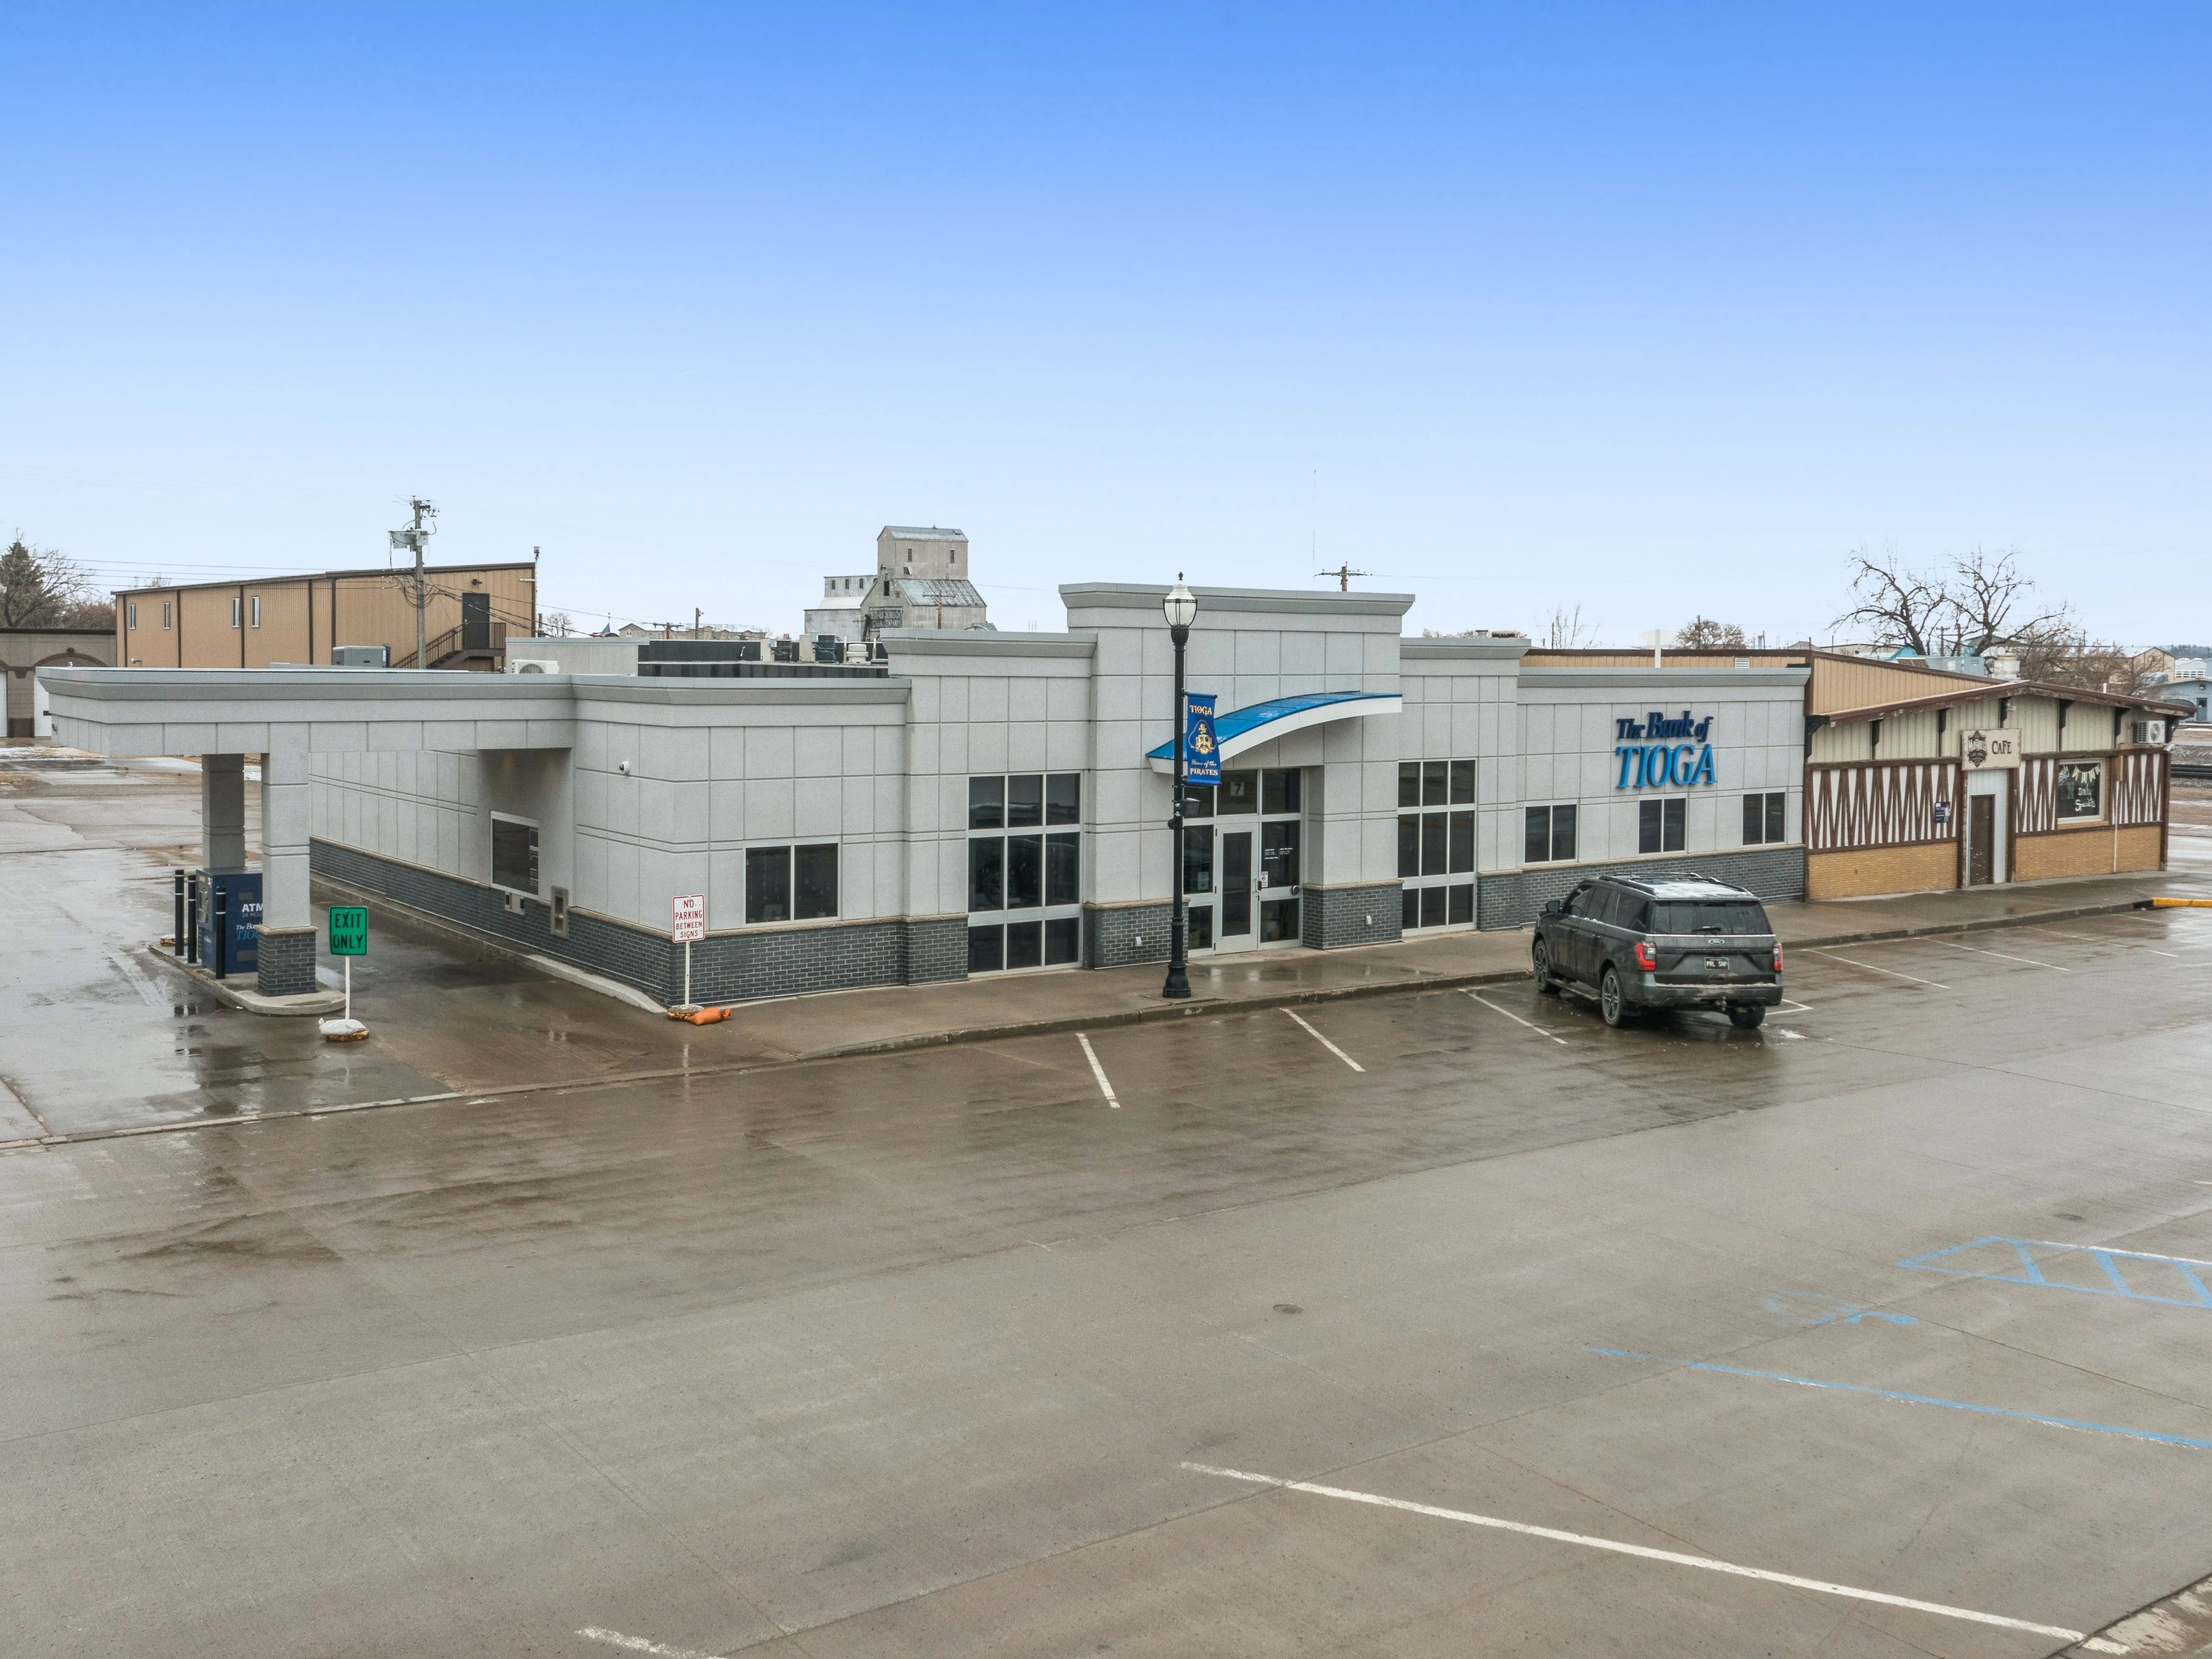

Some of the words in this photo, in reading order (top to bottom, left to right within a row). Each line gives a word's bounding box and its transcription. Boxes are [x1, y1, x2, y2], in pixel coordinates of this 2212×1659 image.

[1189, 705, 1212, 716] TIOGA
[1616, 718, 1646, 739] The
[1645, 710, 1695, 738] Bank
[1694, 716, 1714, 742] of
[1204, 760, 1209, 768] of
[1615, 744, 1718, 788] TIOGA
[1234, 783, 1242, 795] 7
[242, 903, 263, 912] ATM
[684, 899, 694, 908] NO
[335, 913, 361, 928] EXIT
[675, 910, 702, 921] PARKING
[675, 921, 702, 930] BETWEEN
[237, 930, 258, 940] TIO
[680, 930, 698, 938] SIGNS
[333, 934, 363, 949] ONLY
